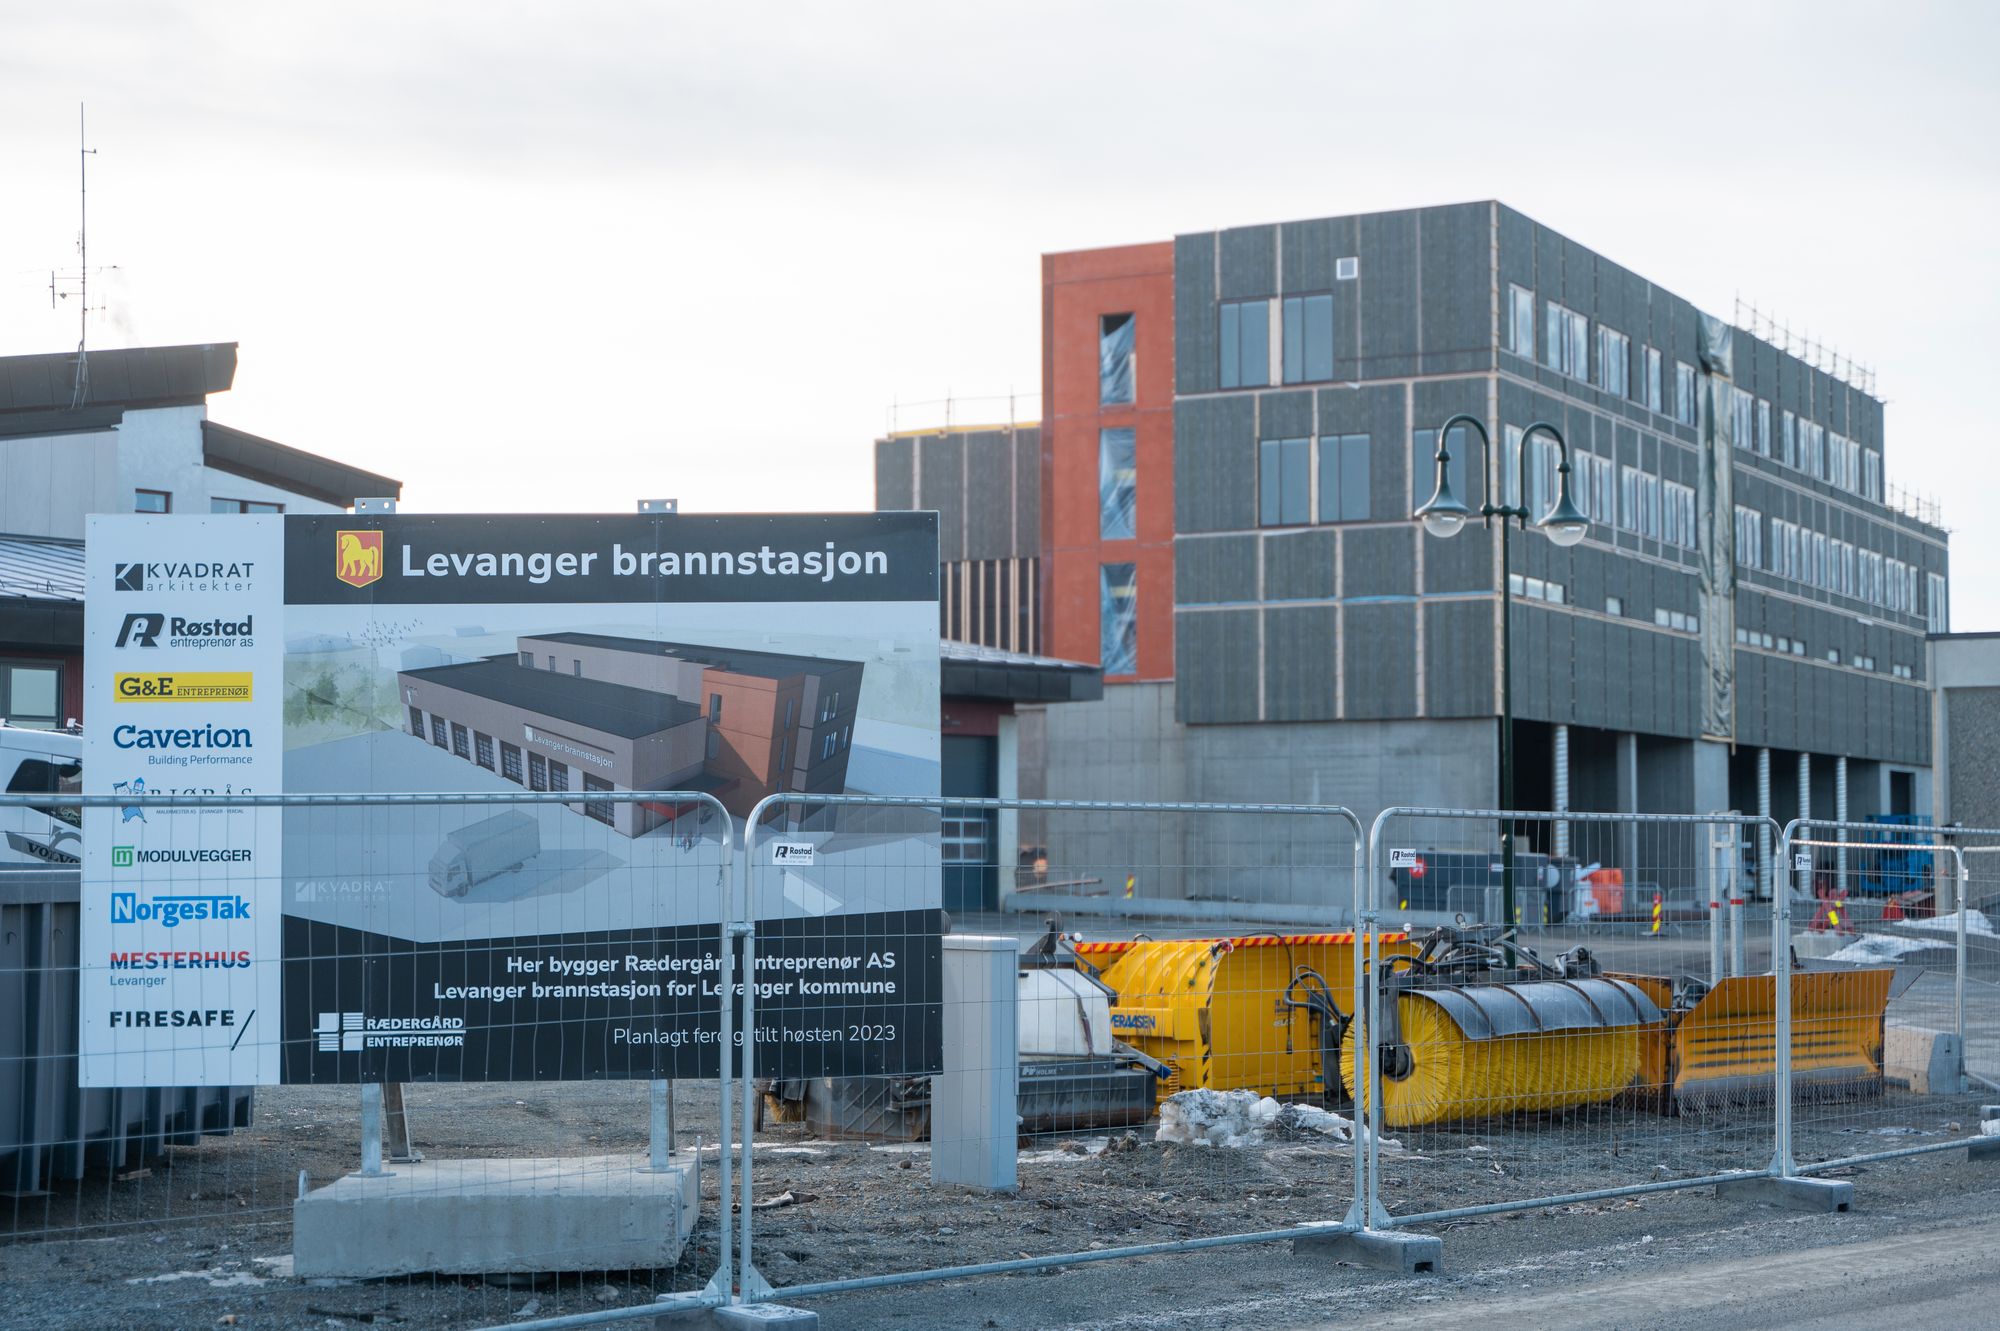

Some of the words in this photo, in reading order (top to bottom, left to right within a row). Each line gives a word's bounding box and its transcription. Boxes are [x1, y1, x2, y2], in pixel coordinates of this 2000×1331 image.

[147, 563, 254, 578] KVADRAT
[402, 544, 597, 583] Levanger
[613, 542, 888, 582] brannstasjon
[147, 580, 252, 591] arkitekter
[171, 615, 253, 636] Røstad
[170, 637, 236, 650] entreprenør
[240, 639, 254, 648] as
[119, 677, 173, 696] G&E
[177, 687, 248, 696] ENTREPRENØR
[113, 723, 252, 749] Caverion
[149, 755, 187, 766] Building
[190, 754, 253, 765] Performance
[533, 734, 564, 752] Levanger
[564, 743, 613, 768] brannstasjon
[137, 849, 252, 863] MODULVEGGER
[318, 880, 393, 893] KVADRAT
[111, 892, 251, 928] NorgesTak
[110, 950, 251, 970] MESTERHUS
[507, 956, 544, 973] Her
[549, 956, 619, 976] bygger
[743, 954, 861, 973] ntreprenør
[866, 952, 896, 969] AS
[110, 976, 166, 988] Levanger
[434, 982, 526, 1002] Levanger
[532, 981, 661, 1000] brannstasjon
[667, 980, 696, 996] for
[799, 978, 896, 995] kommune
[366, 1016, 464, 1029] RÆDERGÅRD
[366, 1036, 464, 1047] ENTREPRENØR
[614, 1028, 689, 1047] Planlagt
[783, 1026, 842, 1042] høsten
[849, 1025, 896, 1042] 2023
